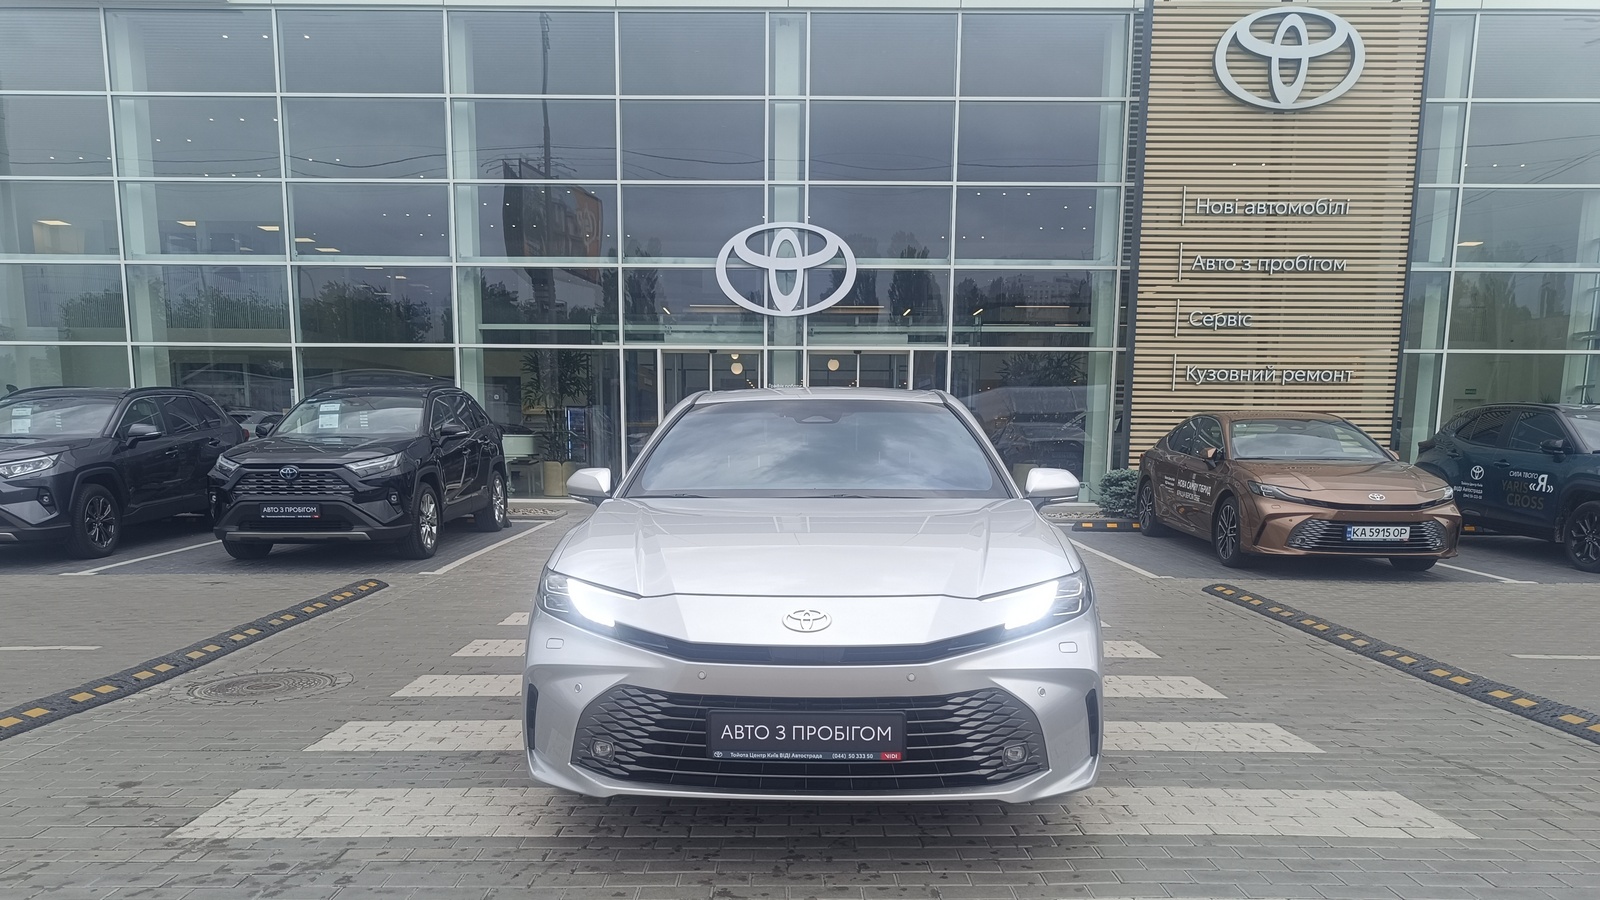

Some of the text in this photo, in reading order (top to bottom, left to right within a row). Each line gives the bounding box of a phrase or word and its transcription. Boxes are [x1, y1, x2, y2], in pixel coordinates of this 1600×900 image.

[1195, 197, 1351, 215] Нові автомобілі
[1191, 254, 1348, 276] Авто з пробігом
[1188, 310, 1254, 331] Сервіс
[1185, 364, 1355, 386] Кузовний ремонт
[1501, 479, 1529, 494] YARIS
[1506, 493, 1545, 510] CROSS
[1352, 527, 1367, 538] KA
[1368, 527, 1391, 538] 5915
[1392, 527, 1408, 538] OP
[720, 724, 893, 742] АВТО З ПРОБІГОМ
